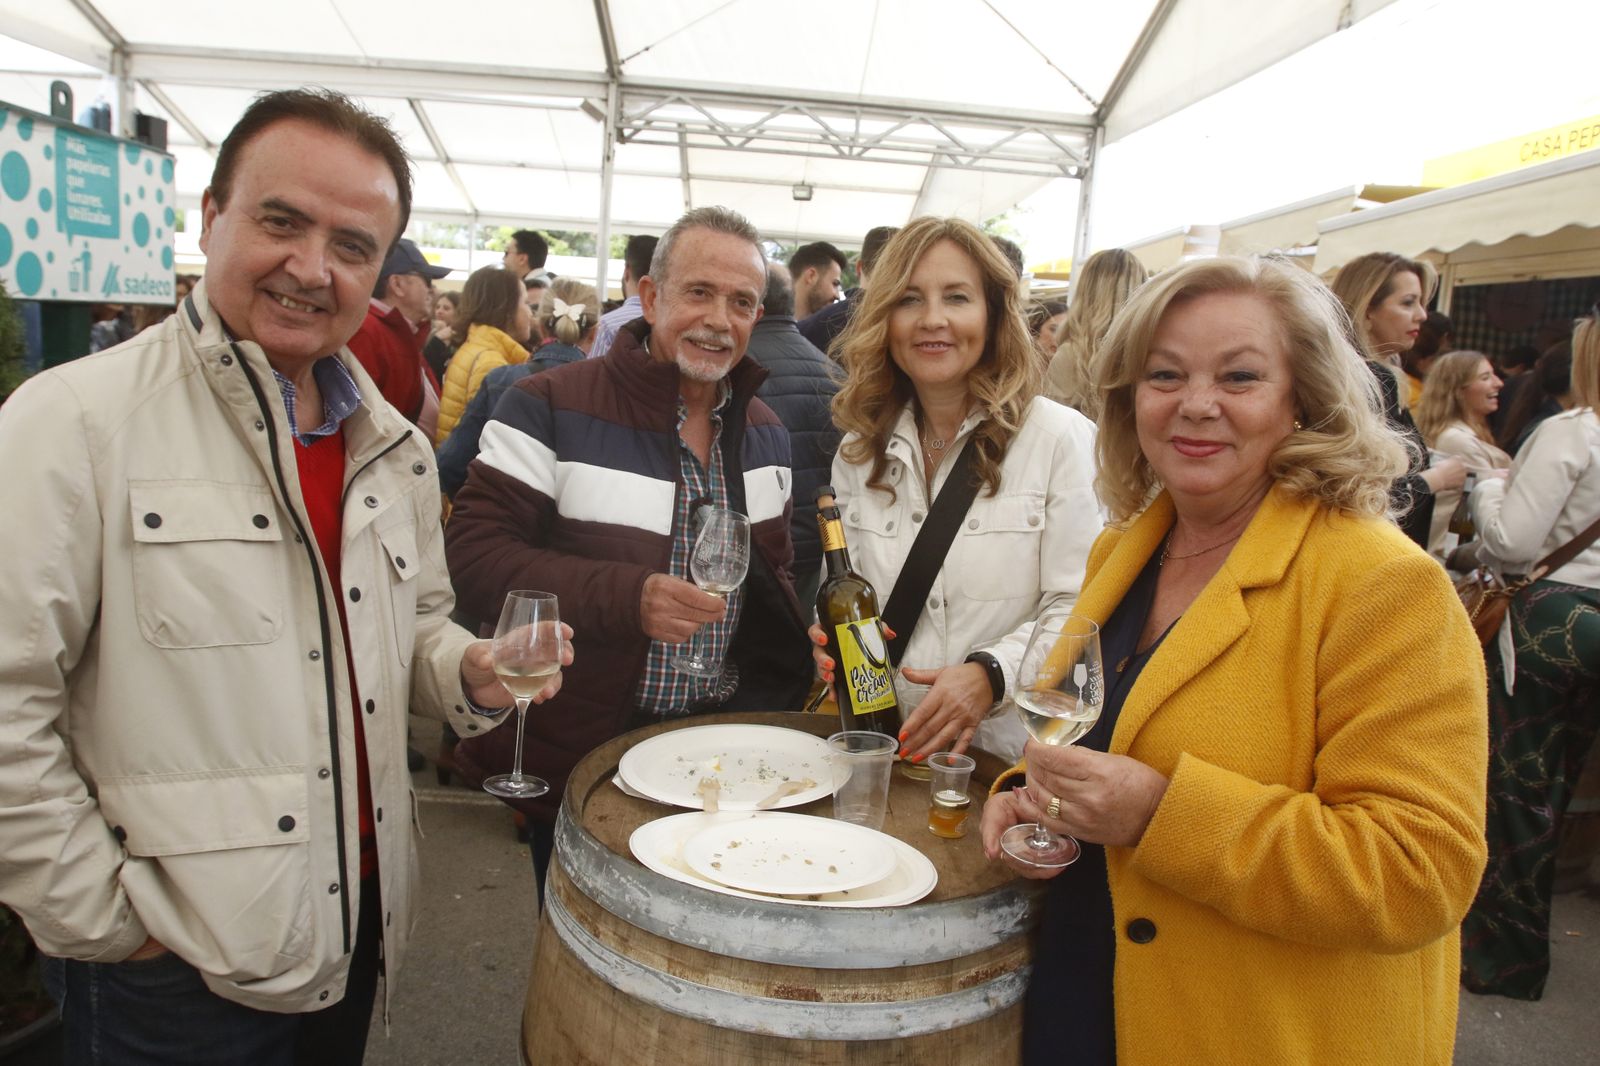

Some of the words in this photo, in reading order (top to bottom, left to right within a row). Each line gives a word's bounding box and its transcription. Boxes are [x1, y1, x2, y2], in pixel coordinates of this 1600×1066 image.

[1519, 134, 1562, 162] CASA
[1567, 124, 1600, 152] PEP
[66, 174, 86, 190] que
[124, 272, 171, 296] sadeco
[850, 664, 877, 689] Pale
[857, 671, 888, 703] cream
